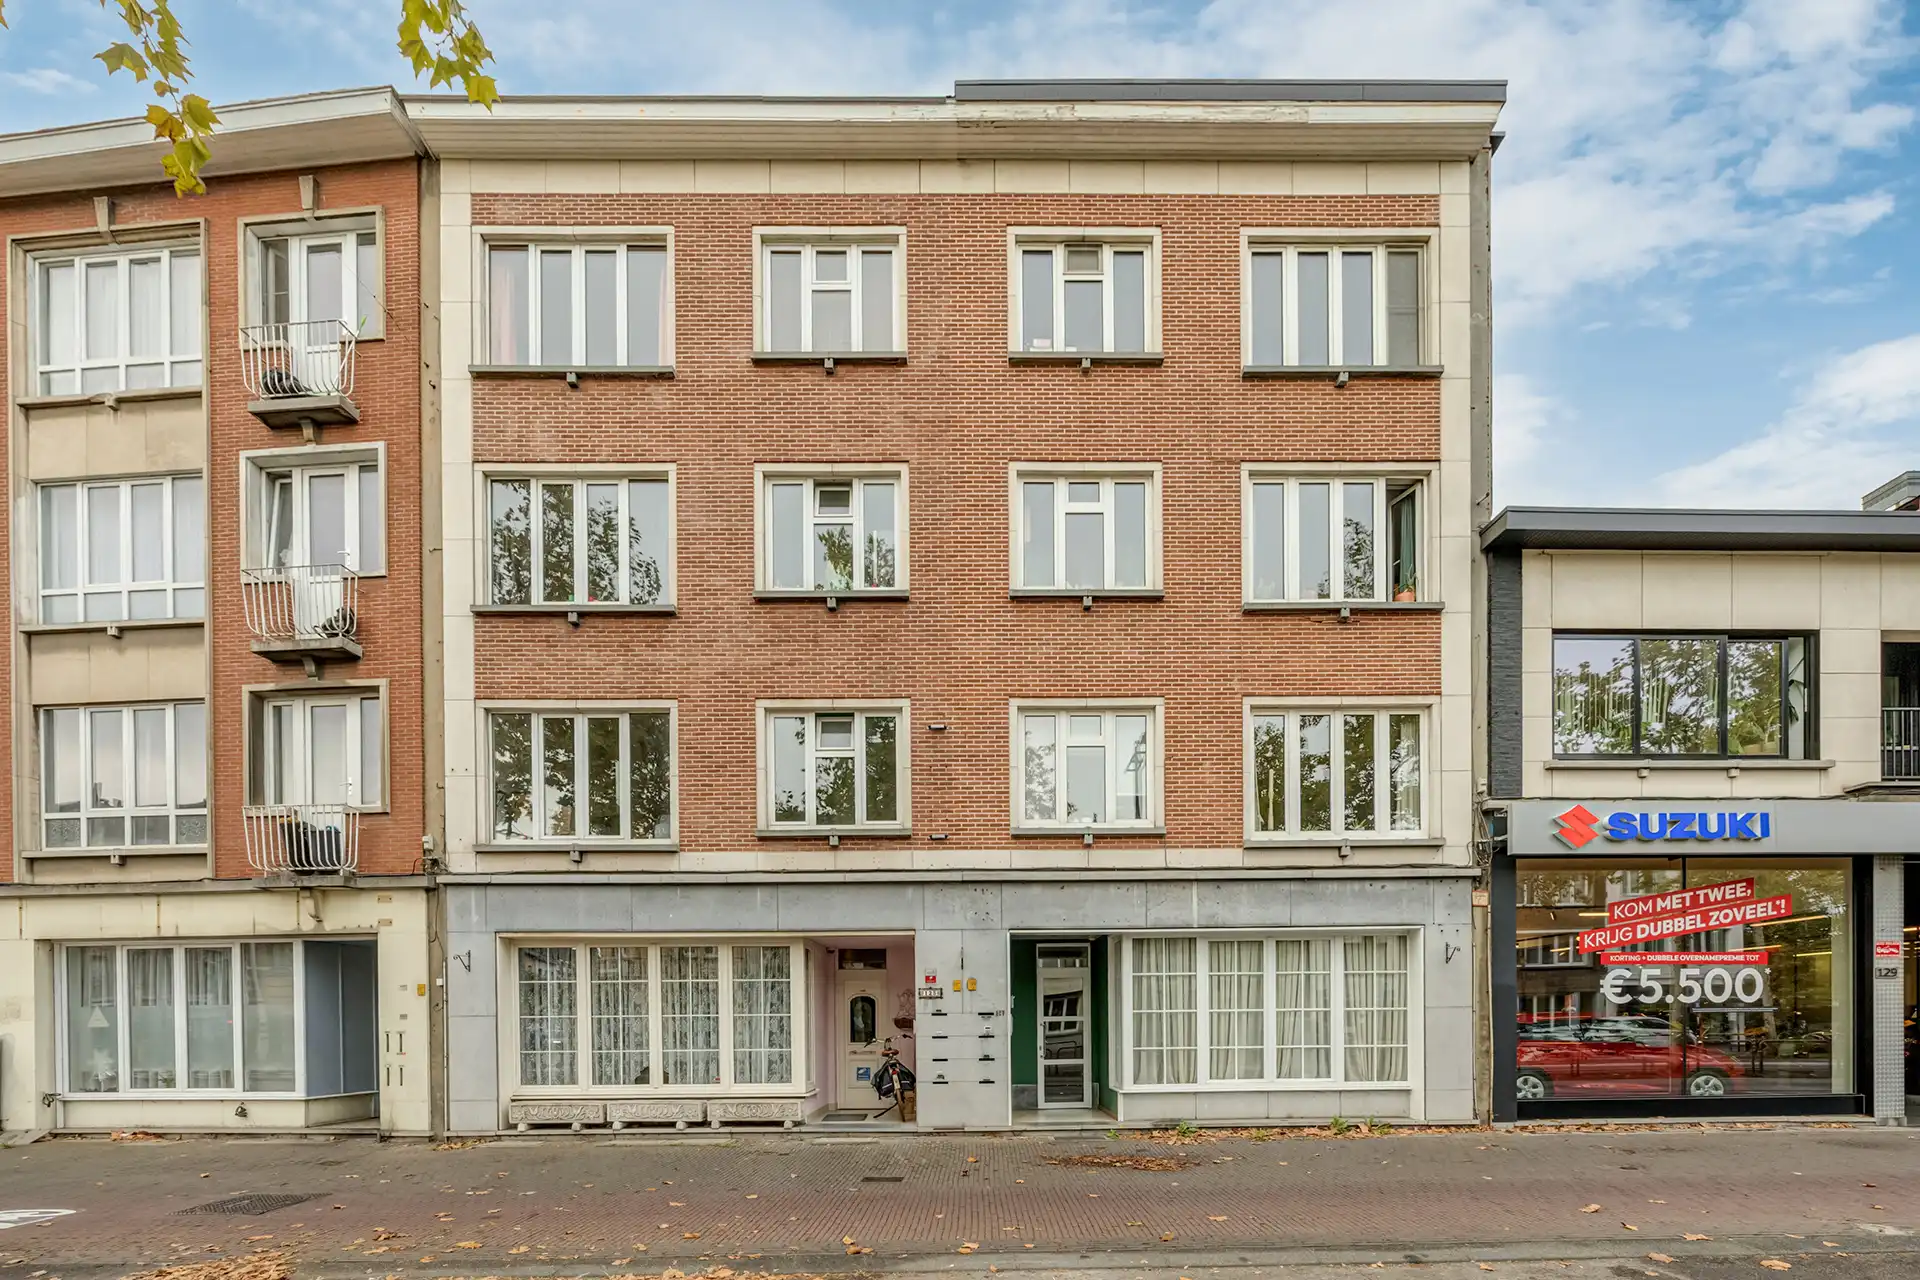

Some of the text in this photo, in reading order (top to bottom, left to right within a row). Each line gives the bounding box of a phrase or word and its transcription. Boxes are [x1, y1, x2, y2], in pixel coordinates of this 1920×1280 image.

[1605, 812, 1770, 840] SUZUKI
[1613, 882, 1752, 919] KOM MET TWEE,
[1584, 927, 1633, 948] KRIJG
[1636, 916, 1706, 939] DUBBEL
[1877, 967, 1898, 977] 129
